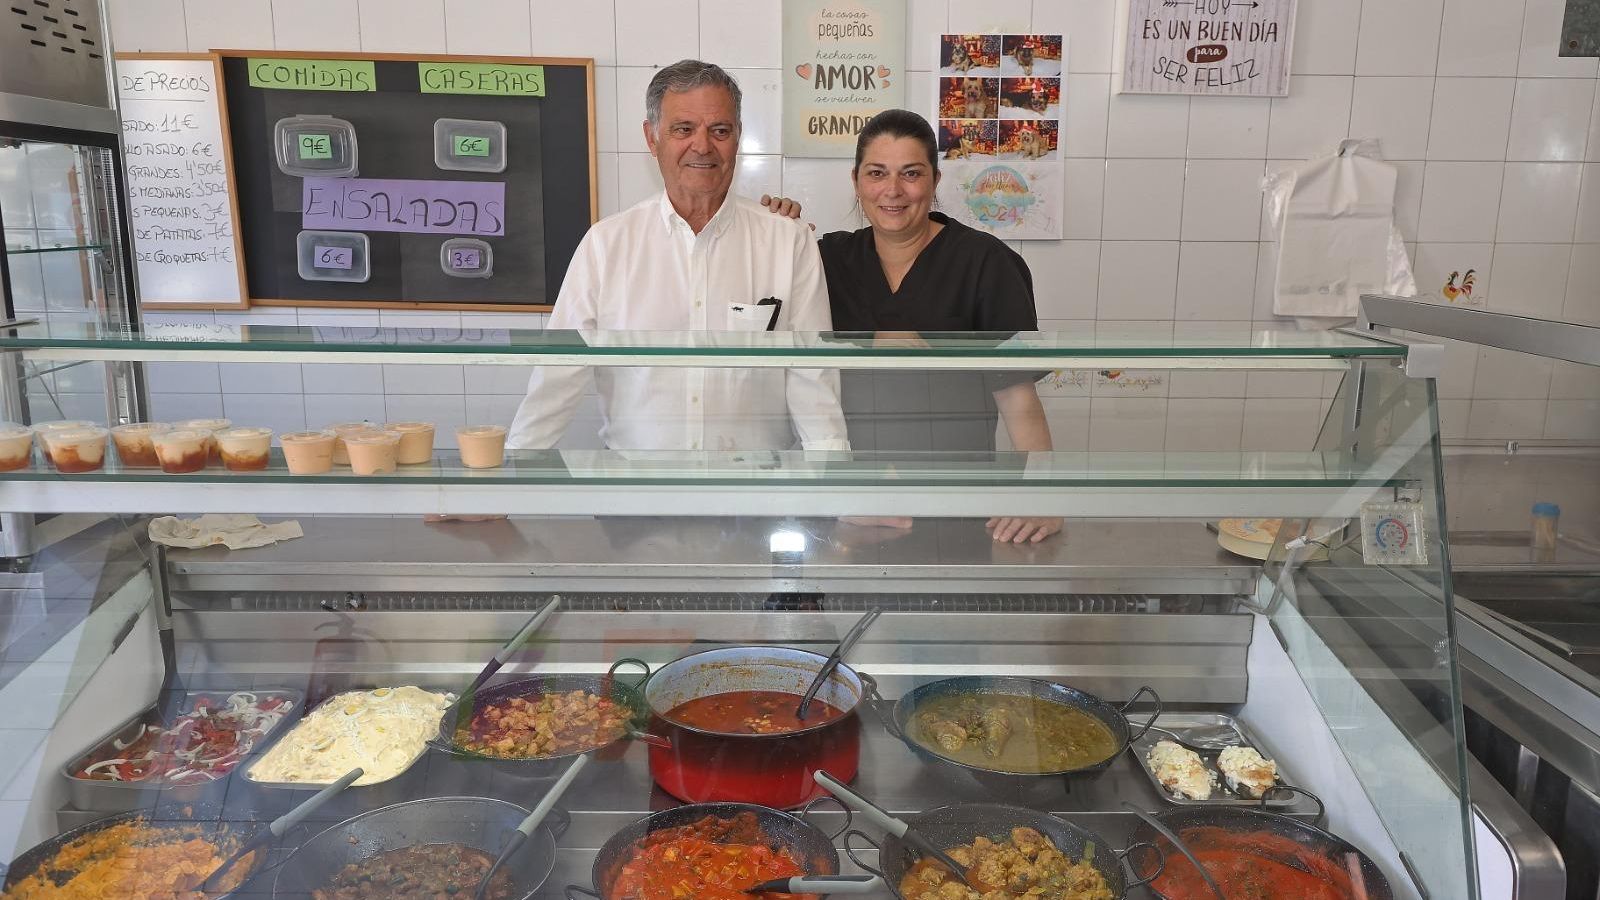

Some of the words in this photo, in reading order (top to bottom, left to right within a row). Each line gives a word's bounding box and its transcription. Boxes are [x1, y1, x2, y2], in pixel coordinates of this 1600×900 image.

[836, 10, 869, 18] cosas
[1195, 0, 1231, 15] HOY
[818, 21, 874, 41] pequeñas
[1142, 19, 1162, 39] ES
[1168, 20, 1191, 40] UN
[1198, 20, 1243, 41] BUEN
[1249, 19, 1278, 44] DÍA
[815, 50, 856, 60] hechas
[1193, 46, 1223, 62] para
[815, 64, 876, 90] AMOR
[1153, 56, 1188, 84] SER
[1194, 59, 1260, 87] FELIZ
[121, 75, 144, 91] DE
[425, 69, 540, 93] CASERAS
[122, 120, 159, 132] SADO:
[160, 112, 199, 133] 11€
[808, 115, 872, 136] GRAND
[192, 142, 213, 157] 6€
[303, 138, 328, 155] 9€
[460, 139, 483, 153] 6€
[305, 186, 502, 234] ENSALADAS
[980, 203, 1017, 221] 2024
[136, 228, 152, 240] DE
[205, 221, 233, 240] 7€
[136, 251, 152, 262] DE
[321, 249, 345, 264] 6€
[454, 252, 474, 267] 3€
